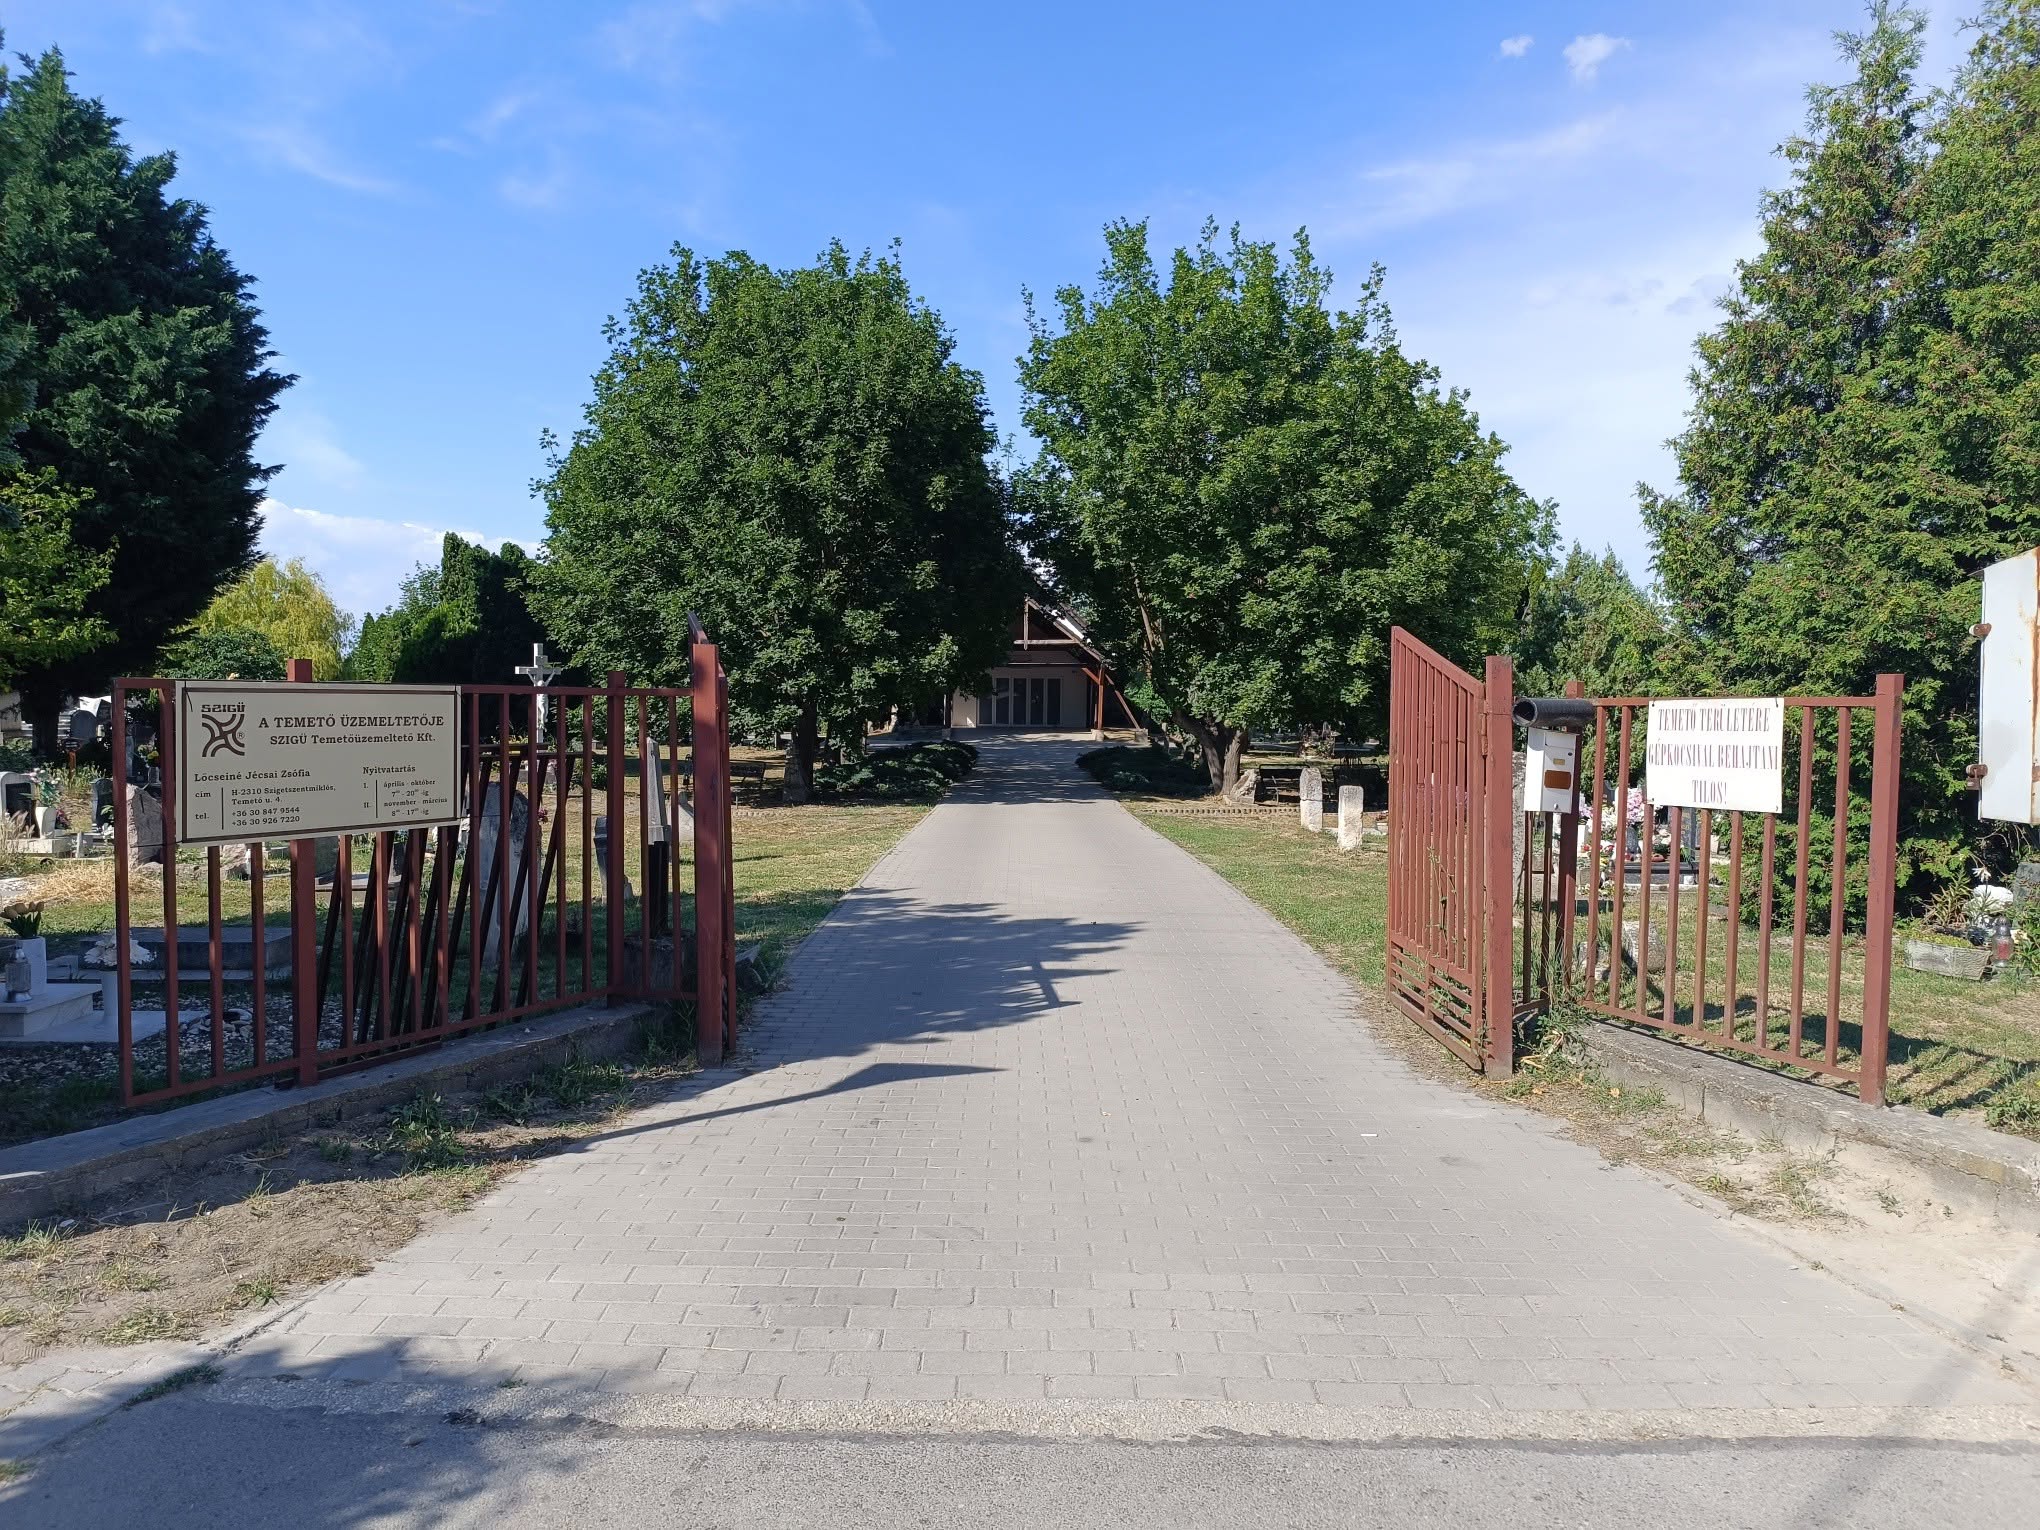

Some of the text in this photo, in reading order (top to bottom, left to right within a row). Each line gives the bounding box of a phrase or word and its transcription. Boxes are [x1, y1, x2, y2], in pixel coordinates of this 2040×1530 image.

[201, 702, 245, 712] SZIGÜ
[258, 713, 444, 728] A TEMETŐ ÜZEMELTETŐJE
[1658, 702, 1770, 732] TEMETŐ TERÜLETÉRE
[270, 733, 436, 744] SZIGÜ Temetőüzemeltető Kft.
[1648, 738, 1778, 770] GÉPKOCSIVAL BEHAJTANI
[246, 770, 278, 780] Jécsai
[281, 769, 310, 778] Zsófia
[362, 765, 416, 776] Nyitvatartás
[232, 788, 262, 796] H-2310
[1692, 779, 1727, 804] TILOS!
